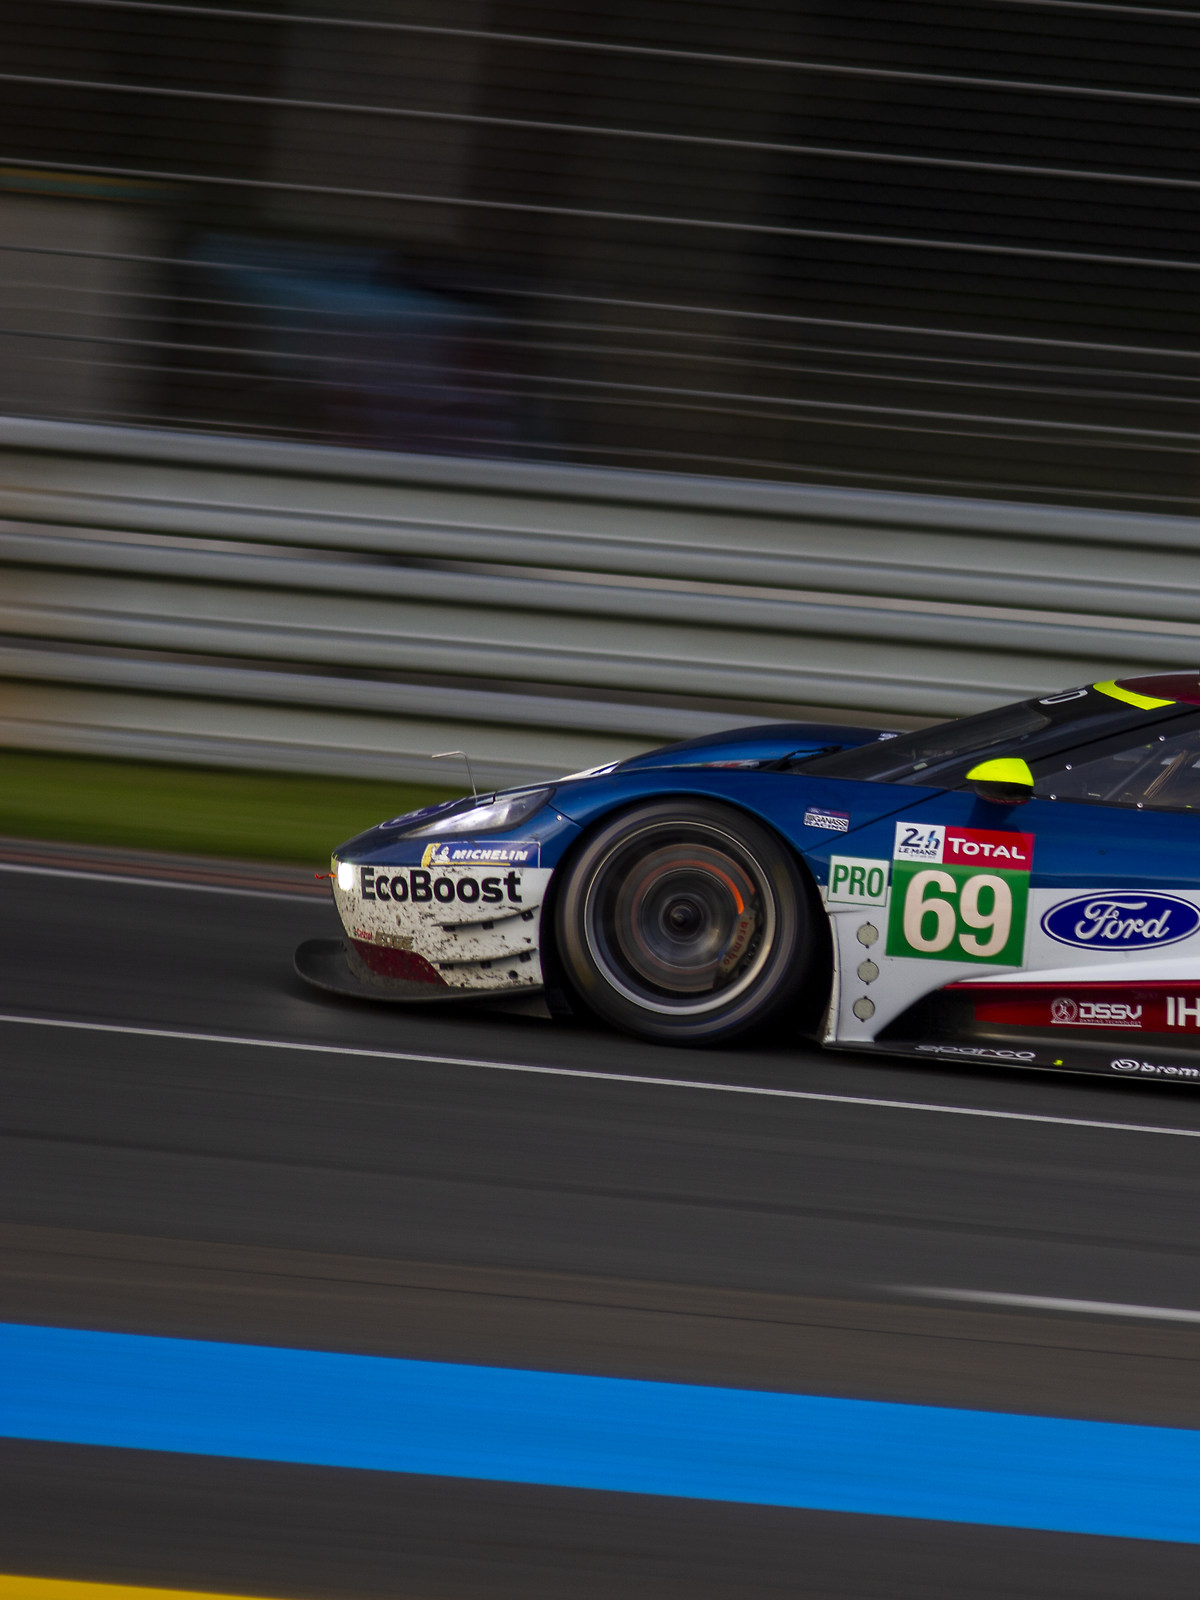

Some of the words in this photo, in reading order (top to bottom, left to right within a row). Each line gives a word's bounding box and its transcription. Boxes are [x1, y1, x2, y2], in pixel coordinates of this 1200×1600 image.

[452, 849, 528, 861] MICHELIN
[911, 848, 937, 856] MANS
[948, 837, 1026, 860] TOTAL
[360, 867, 523, 903] EcoBoost
[832, 864, 884, 898] PRO
[903, 869, 1013, 958] 69
[1074, 900, 1172, 941] Ford
[1079, 1002, 1142, 1020] DSSV
[915, 1044, 1037, 1060] sparco
